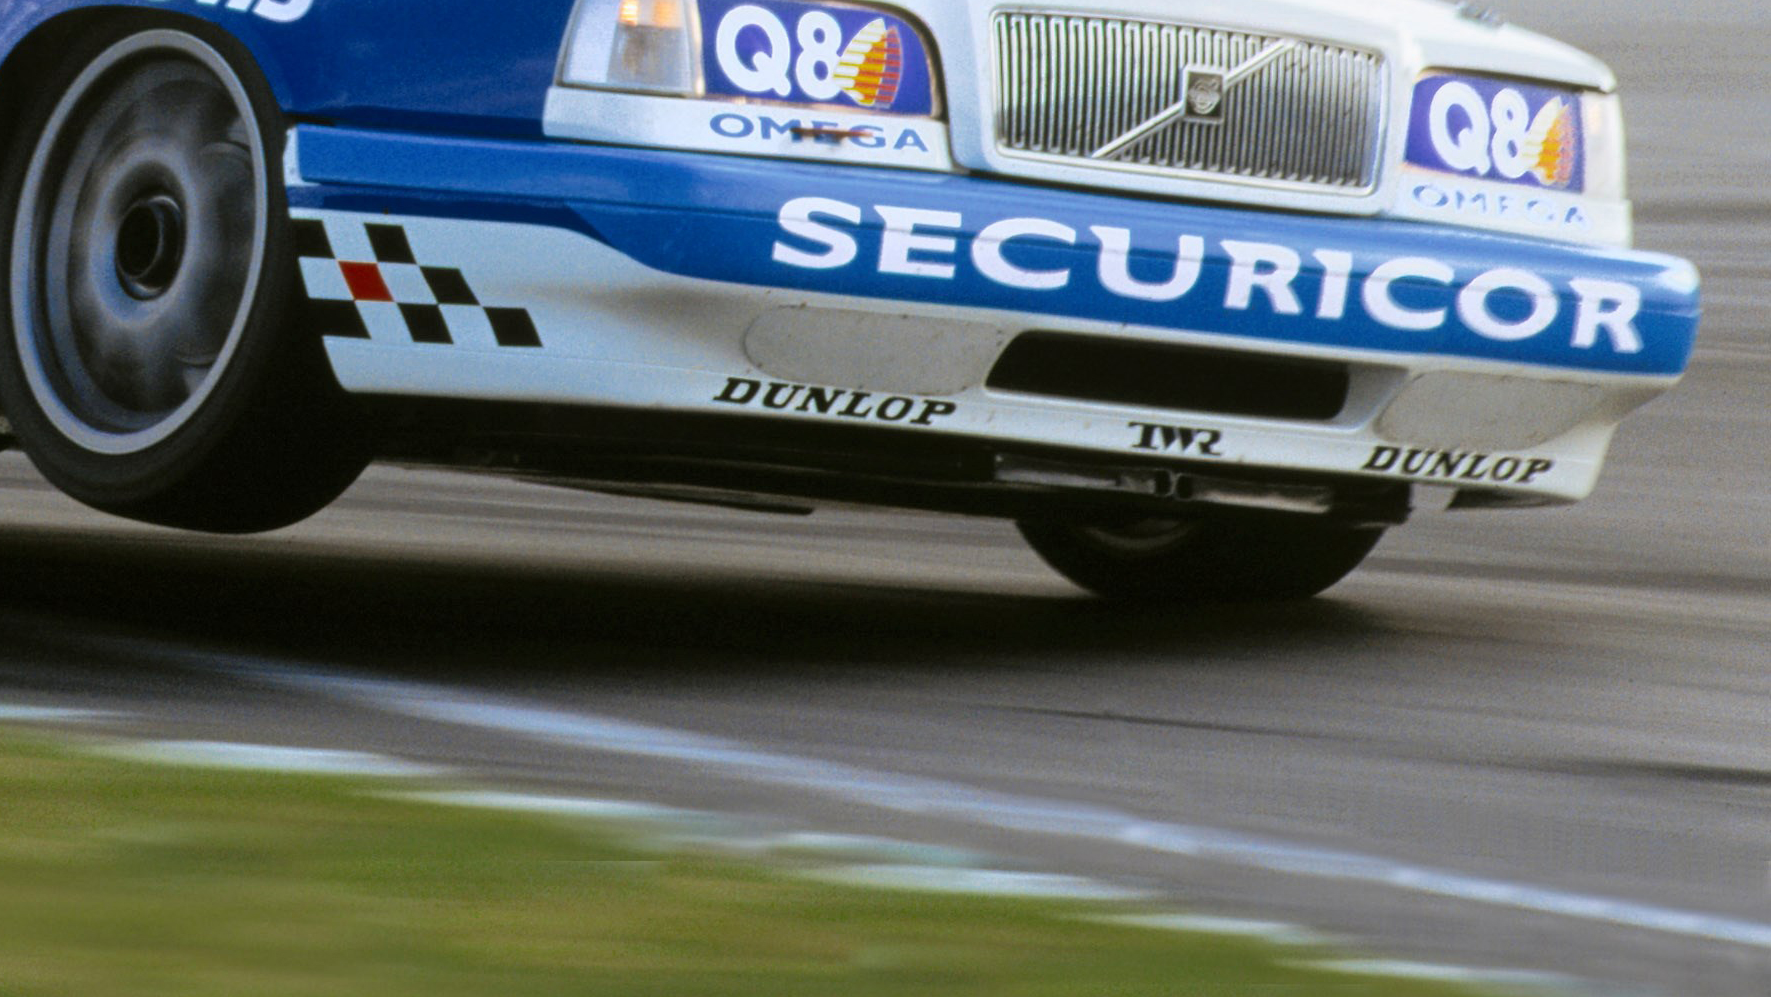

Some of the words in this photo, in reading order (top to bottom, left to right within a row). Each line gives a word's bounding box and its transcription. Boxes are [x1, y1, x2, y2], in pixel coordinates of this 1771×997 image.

[715, 4, 842, 100] Q8
[709, 113, 929, 153] OMEGA
[1429, 80, 1529, 179] Q8
[771, 196, 1643, 354] SECURICOR
[713, 377, 956, 426] DUNLOP
[1128, 421, 1224, 458] TWR
[1361, 445, 1555, 484] DUNLOP
